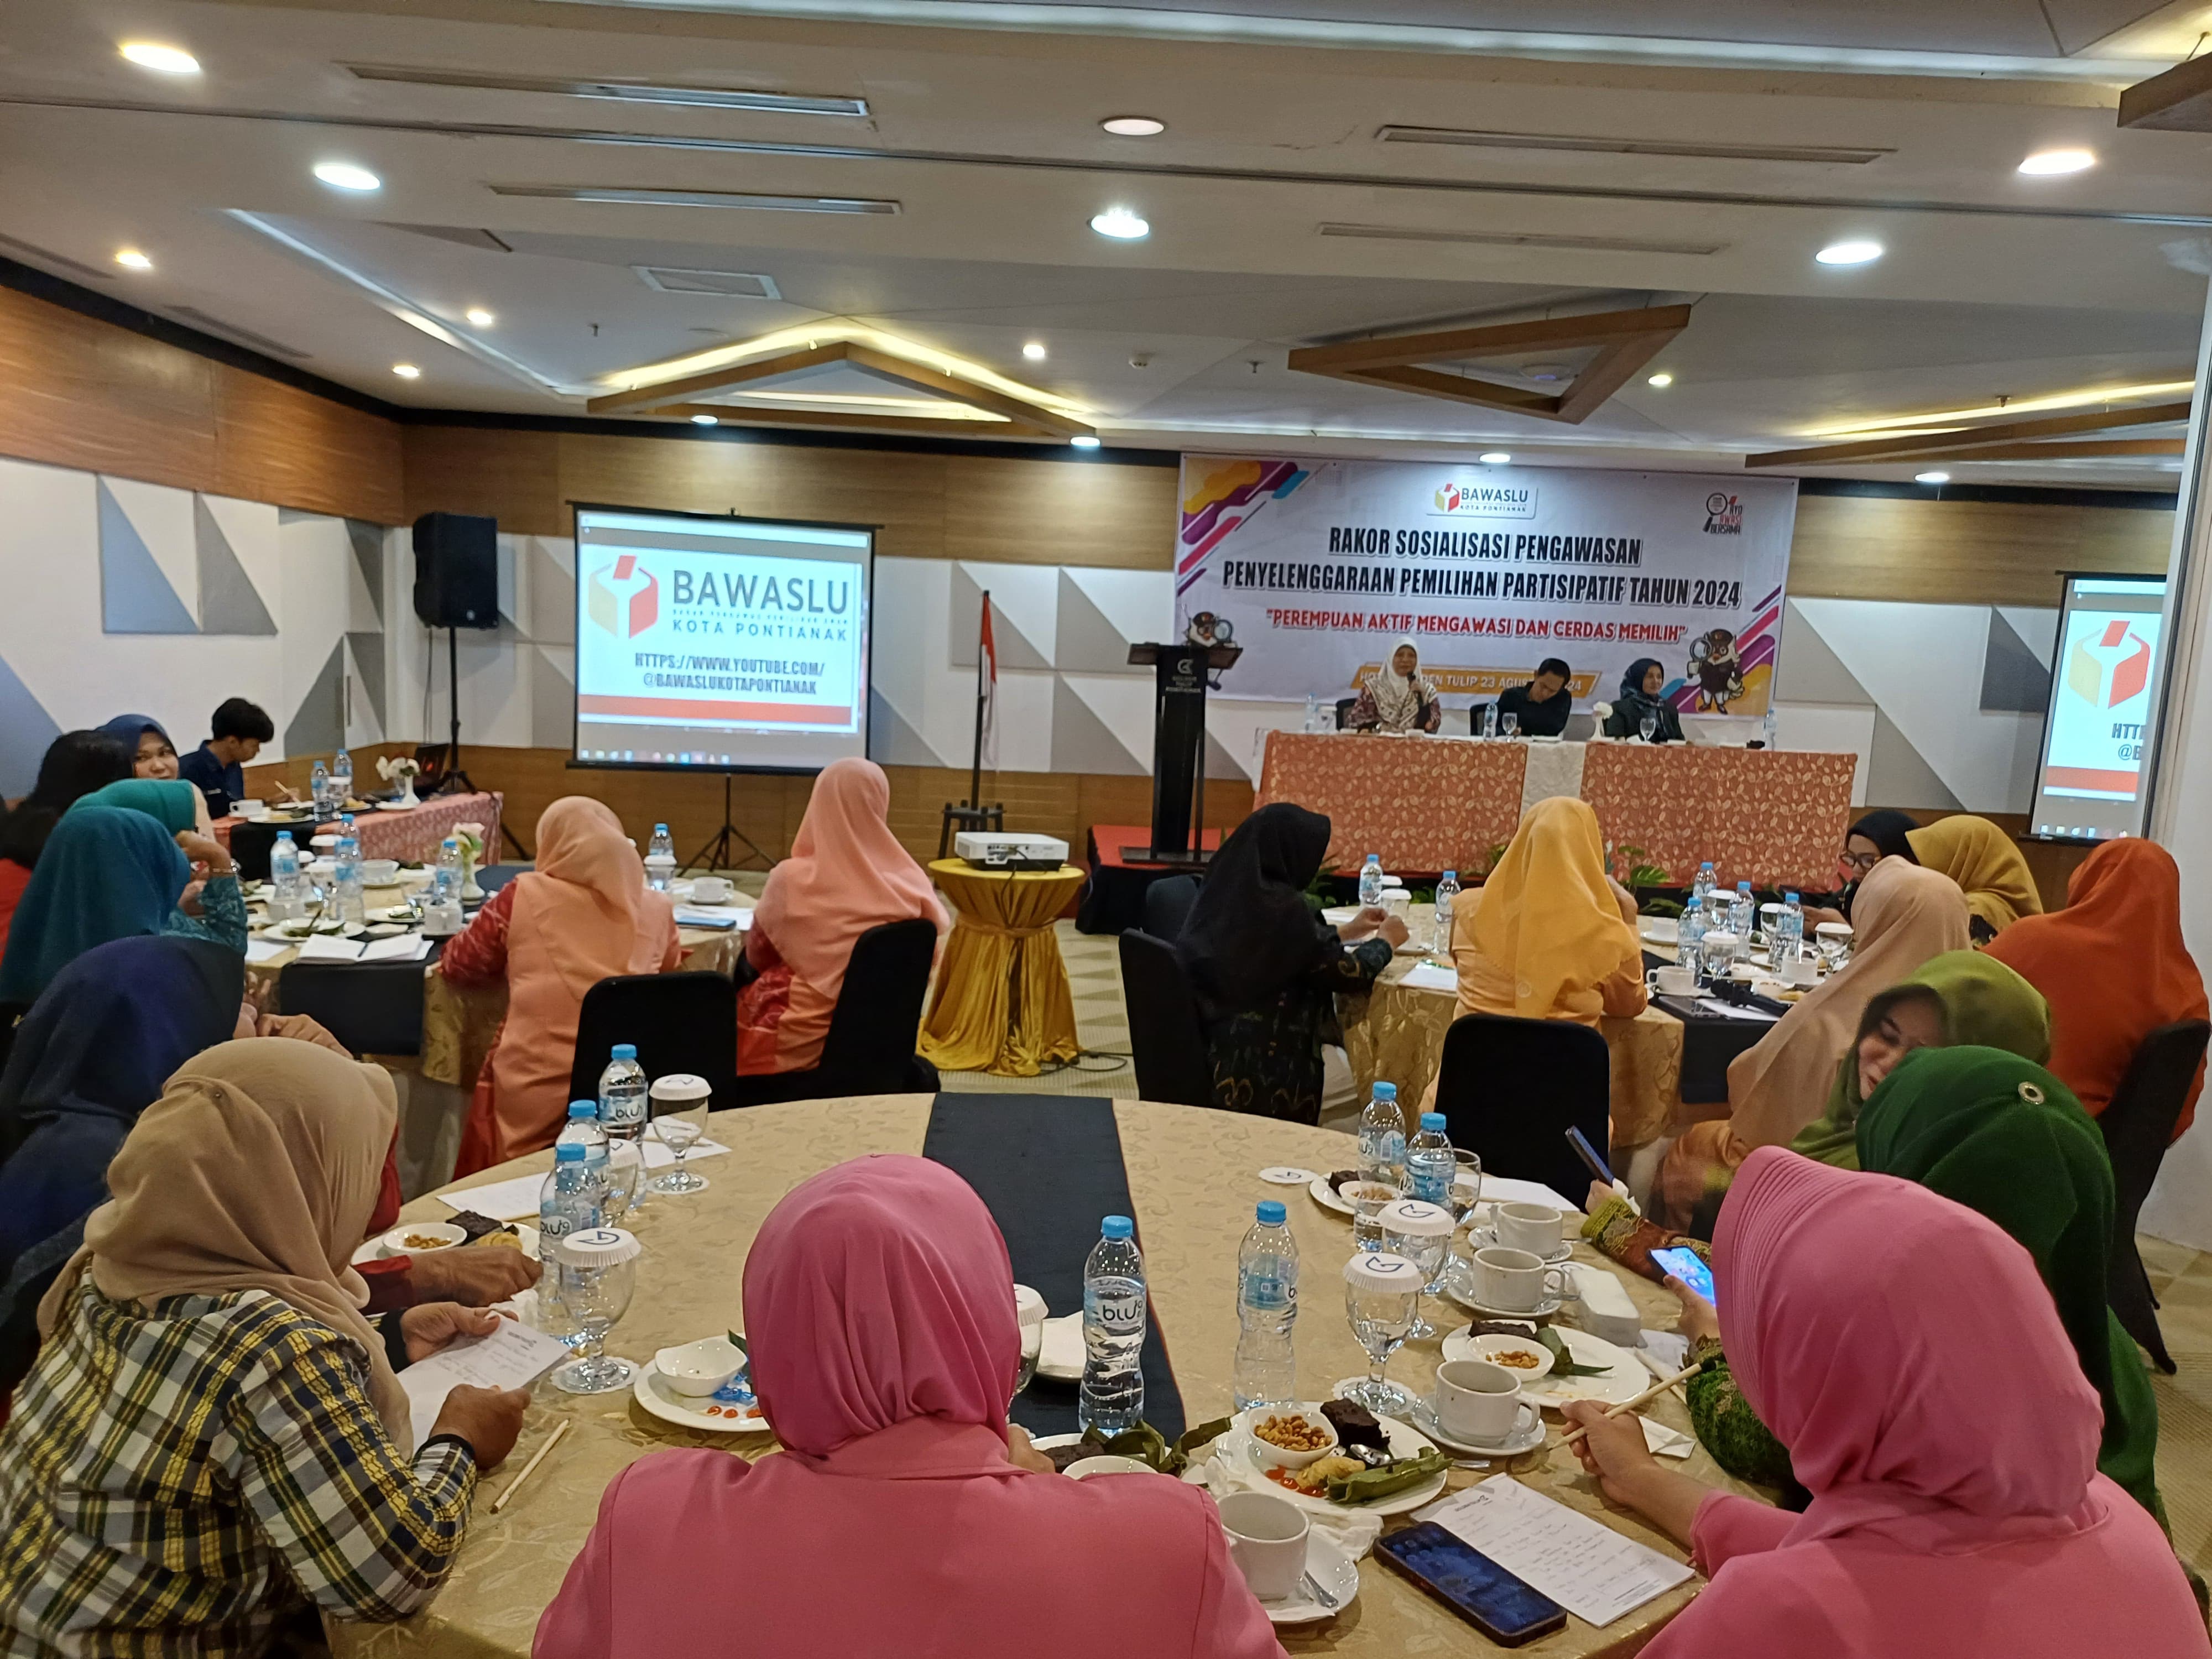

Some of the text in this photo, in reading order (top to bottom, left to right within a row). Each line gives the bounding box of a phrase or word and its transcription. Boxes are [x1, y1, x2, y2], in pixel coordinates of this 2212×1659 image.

[1462, 487, 1528, 503] BAWASLU
[1329, 527, 1642, 565] RAKOR SOSIALISASI PENGAWASAN
[674, 570, 849, 614] BAWASLU
[1223, 560, 1741, 607] PENYELENGGARAAN PEMILIHAN PARTISIPATIF TAHUN 2024
[672, 619, 847, 641] KOTA PONTIANAK
[1266, 609, 1687, 641] "PEREMPUAN AKTIF MENGAWASI DAN CERDAS MEMILIH"
[635, 653, 825, 677] HTTPS://WWW.YOUTUBE.COM/
[1446, 675, 1478, 687] TULIP
[1480, 676, 1495, 688] 23
